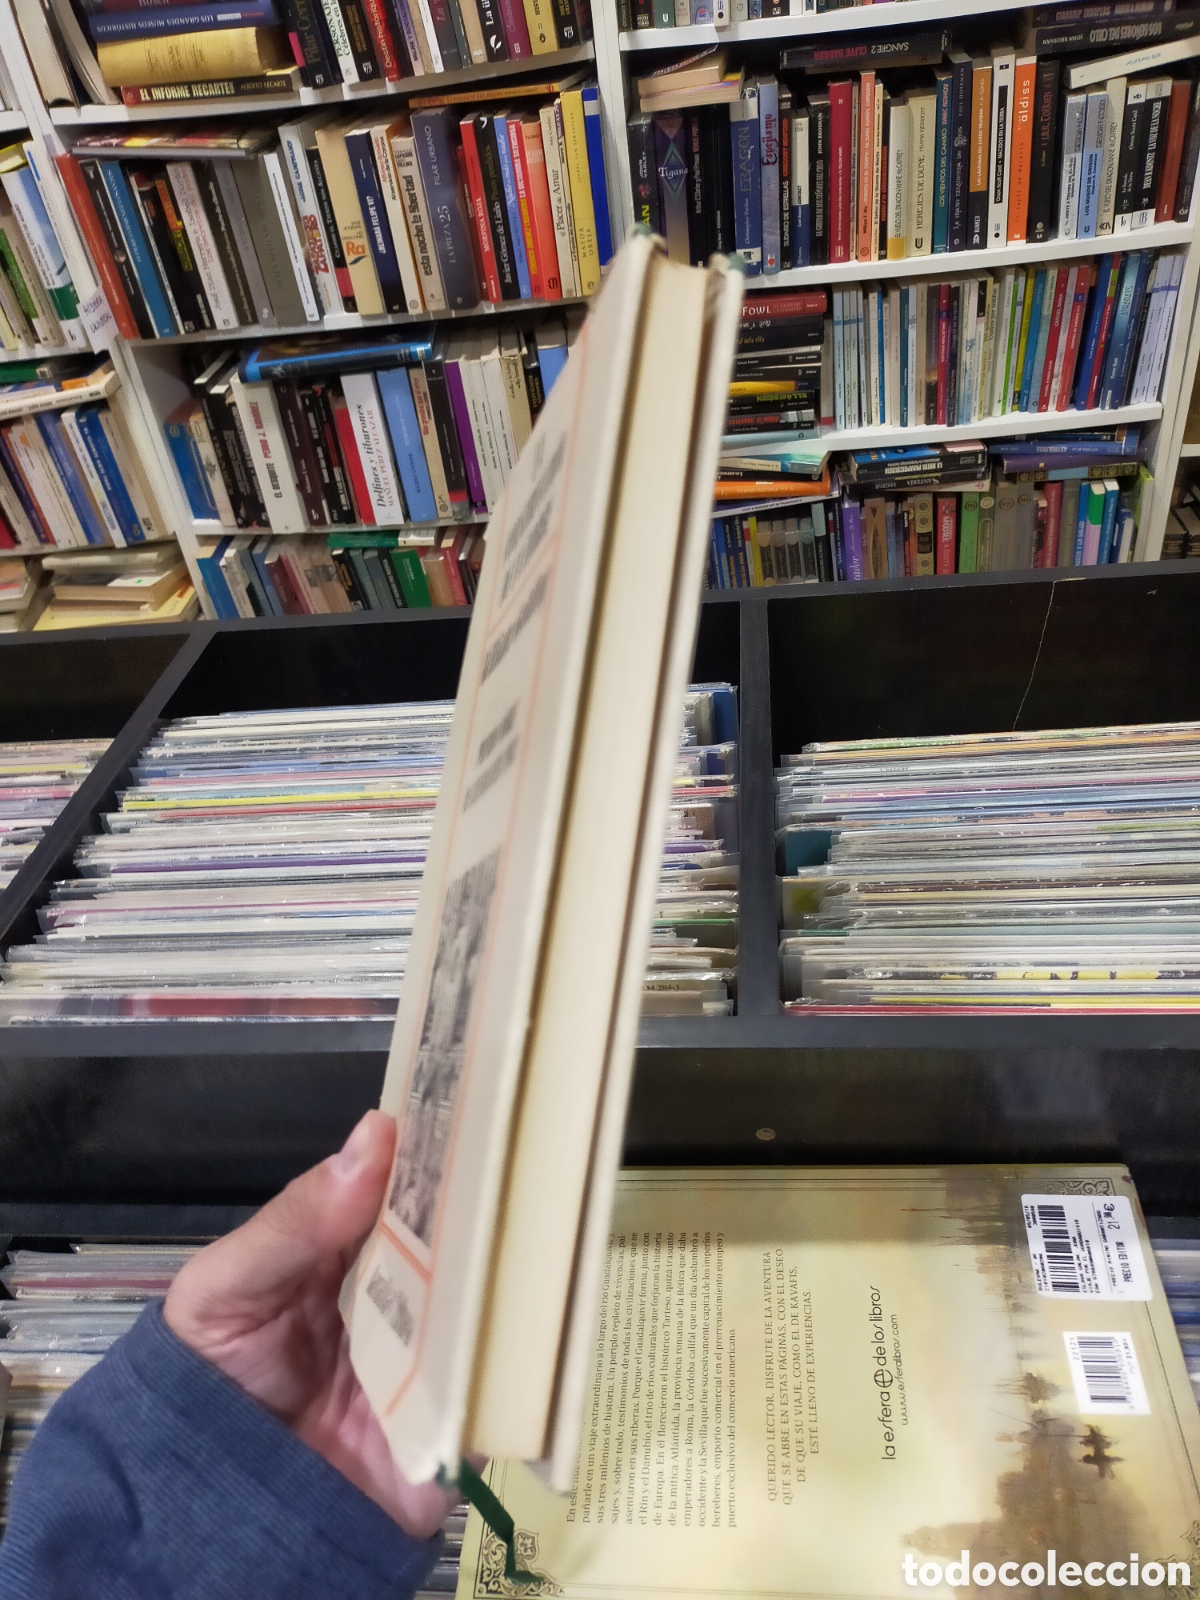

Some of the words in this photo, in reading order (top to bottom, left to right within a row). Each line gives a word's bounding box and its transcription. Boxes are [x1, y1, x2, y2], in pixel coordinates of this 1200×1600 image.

[1107, 28, 1121, 40] DEL
[1150, 22, 1162, 36] LOS
[878, 42, 909, 54] SANGRE
[139, 86, 151, 101] EL
[152, 84, 190, 100] INFORME
[1018, 80, 1030, 122] aldiss
[424, 126, 438, 162] URBANO
[761, 114, 778, 166] Espejismo
[432, 164, 442, 186] PILAR
[550, 170, 562, 194] Amar
[658, 166, 688, 180] Tigana
[938, 168, 946, 192] VIENTOS
[402, 174, 420, 214] libertad
[918, 180, 924, 191] DE
[368, 206, 380, 226] FELIPE
[412, 214, 422, 224] la
[438, 204, 452, 222] 25
[476, 197, 486, 218] ROJA
[554, 204, 566, 230] Placer
[783, 212, 790, 220] DE
[496, 224, 505, 234] de
[498, 236, 510, 262] Gómez
[421, 254, 434, 276] esta
[356, 404, 374, 446] tiburones
[370, 466, 387, 508] Delfines
[942, 516, 950, 543] MOORE
[665, 1232, 674, 1268] trasunto
[1116, 1241, 1128, 1260] EDITOR
[664, 1268, 674, 1293] quizá
[1108, 1266, 1117, 1286] PRECIO
[1120, 1262, 1134, 1282] PRECIO
[777, 1284, 784, 1295] EL
[790, 1264, 799, 1309] KAVAFIS,
[663, 1294, 672, 1328] Tarteso,
[765, 1304, 772, 1318] LA
[867, 1286, 884, 1322] libros
[765, 1320, 772, 1335] DE
[792, 1313, 799, 1326] DE
[804, 1288, 814, 1365] EXPERIENCIAS.
[778, 1321, 787, 1371] PÁGINAS,
[792, 1329, 799, 1343] EL
[661, 1330, 669, 1371] histórico
[660, 1373, 668, 1382] el
[808, 1367, 815, 1383] DE
[889, 1314, 908, 1426] www.esferalibros.com
[794, 1382, 803, 1415] VIAJE,
[808, 1384, 817, 1423] LLENO
[658, 1384, 667, 1437] florecieron
[767, 1393, 775, 1440] LECTOR,
[781, 1408, 788, 1425] EN
[878, 1391, 894, 1442] esfera
[796, 1418, 803, 1434] SU
[658, 1439, 665, 1449] él
[796, 1438, 806, 1463] QUE
[809, 1428, 818, 1455] ESTÉ
[657, 1451, 664, 1465] En
[783, 1461, 790, 1474] SE
[768, 1442, 777, 1502] QUERIDO
[798, 1467, 805, 1483] DE
[655, 1469, 665, 1509] Europa.
[784, 1481, 792, 1506] QUE
[654, 1512, 662, 1526] de
[728, 1491, 736, 1528] puerto
